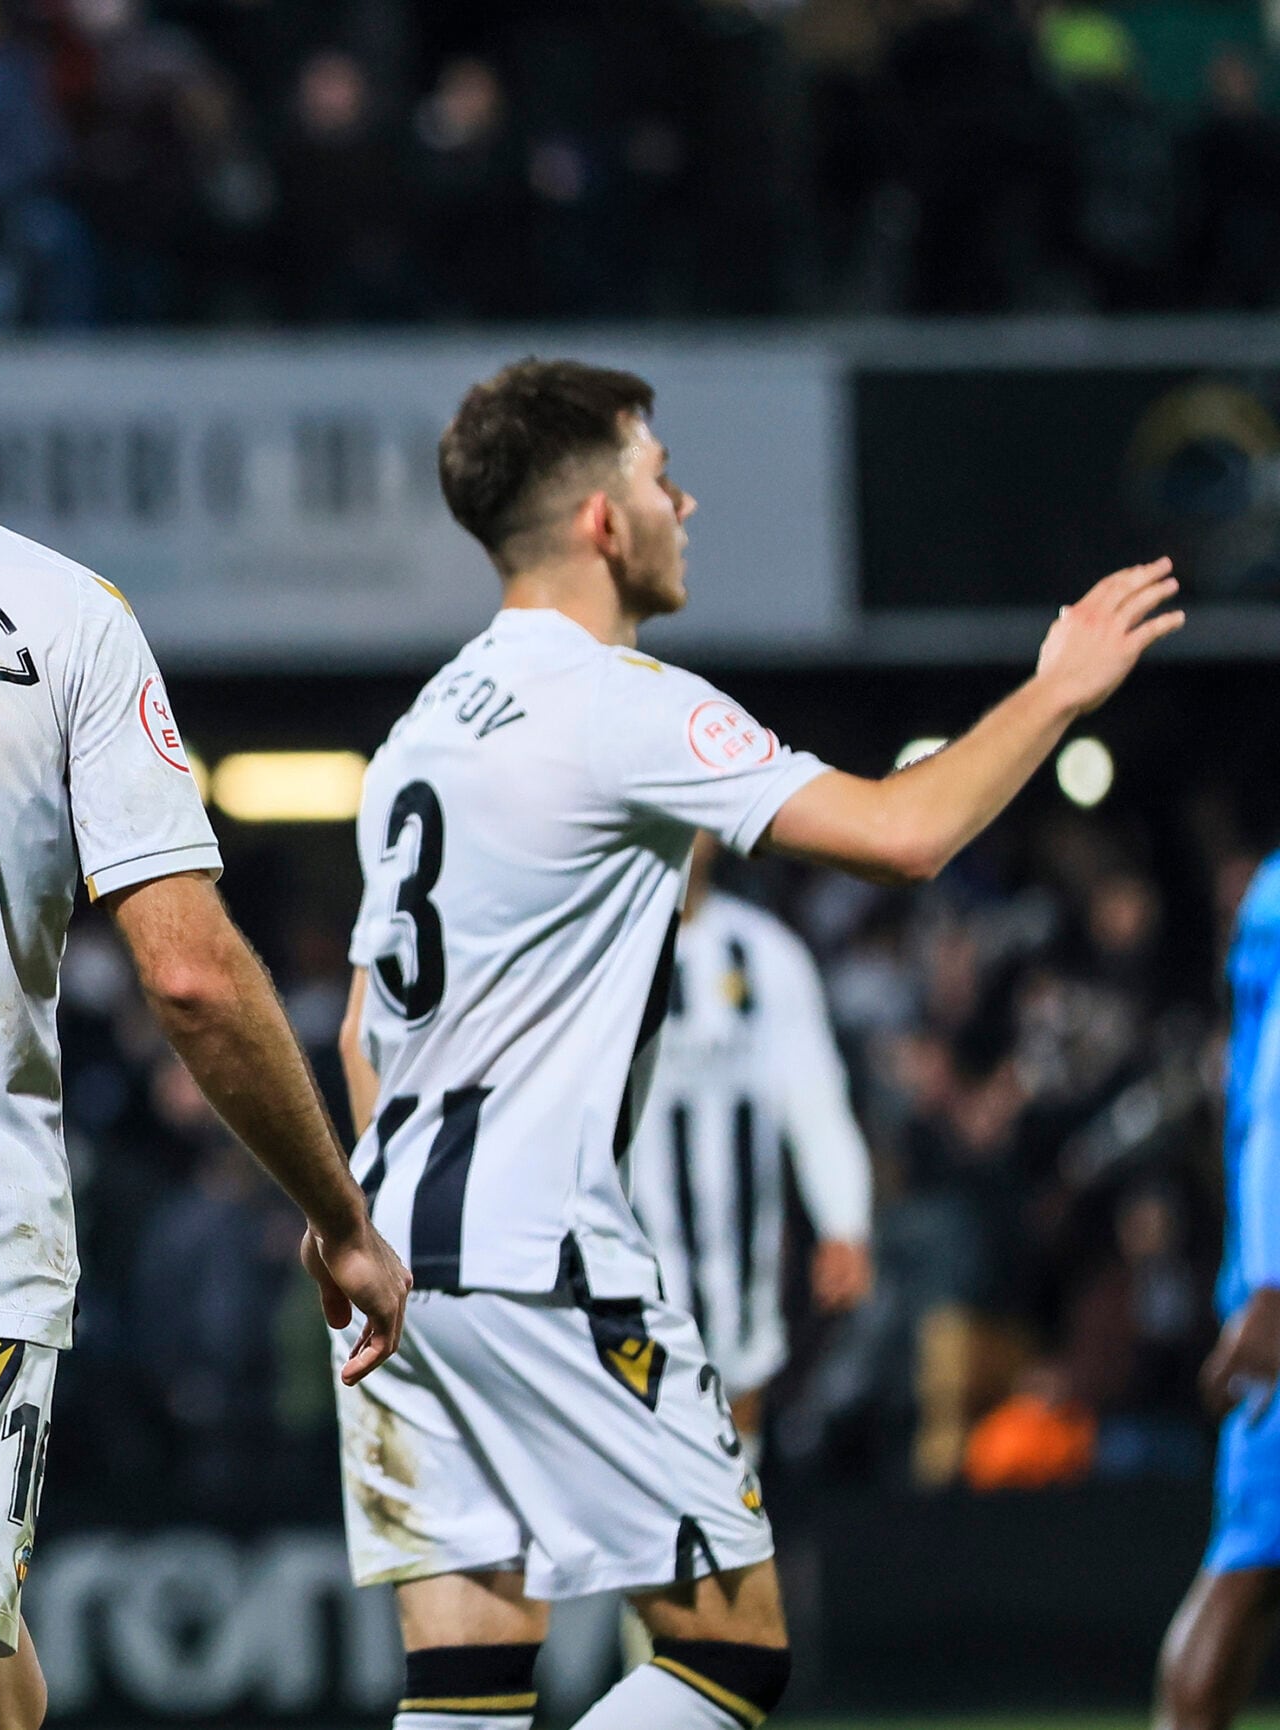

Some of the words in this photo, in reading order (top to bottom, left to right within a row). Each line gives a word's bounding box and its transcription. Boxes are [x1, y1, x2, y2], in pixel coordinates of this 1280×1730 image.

[421, 670, 526, 741] FOV
[372, 779, 447, 1032] 3
[1, 1401, 51, 1527] 1
[696, 1363, 742, 1459] 3
[25, 1525, 412, 1722] ron
